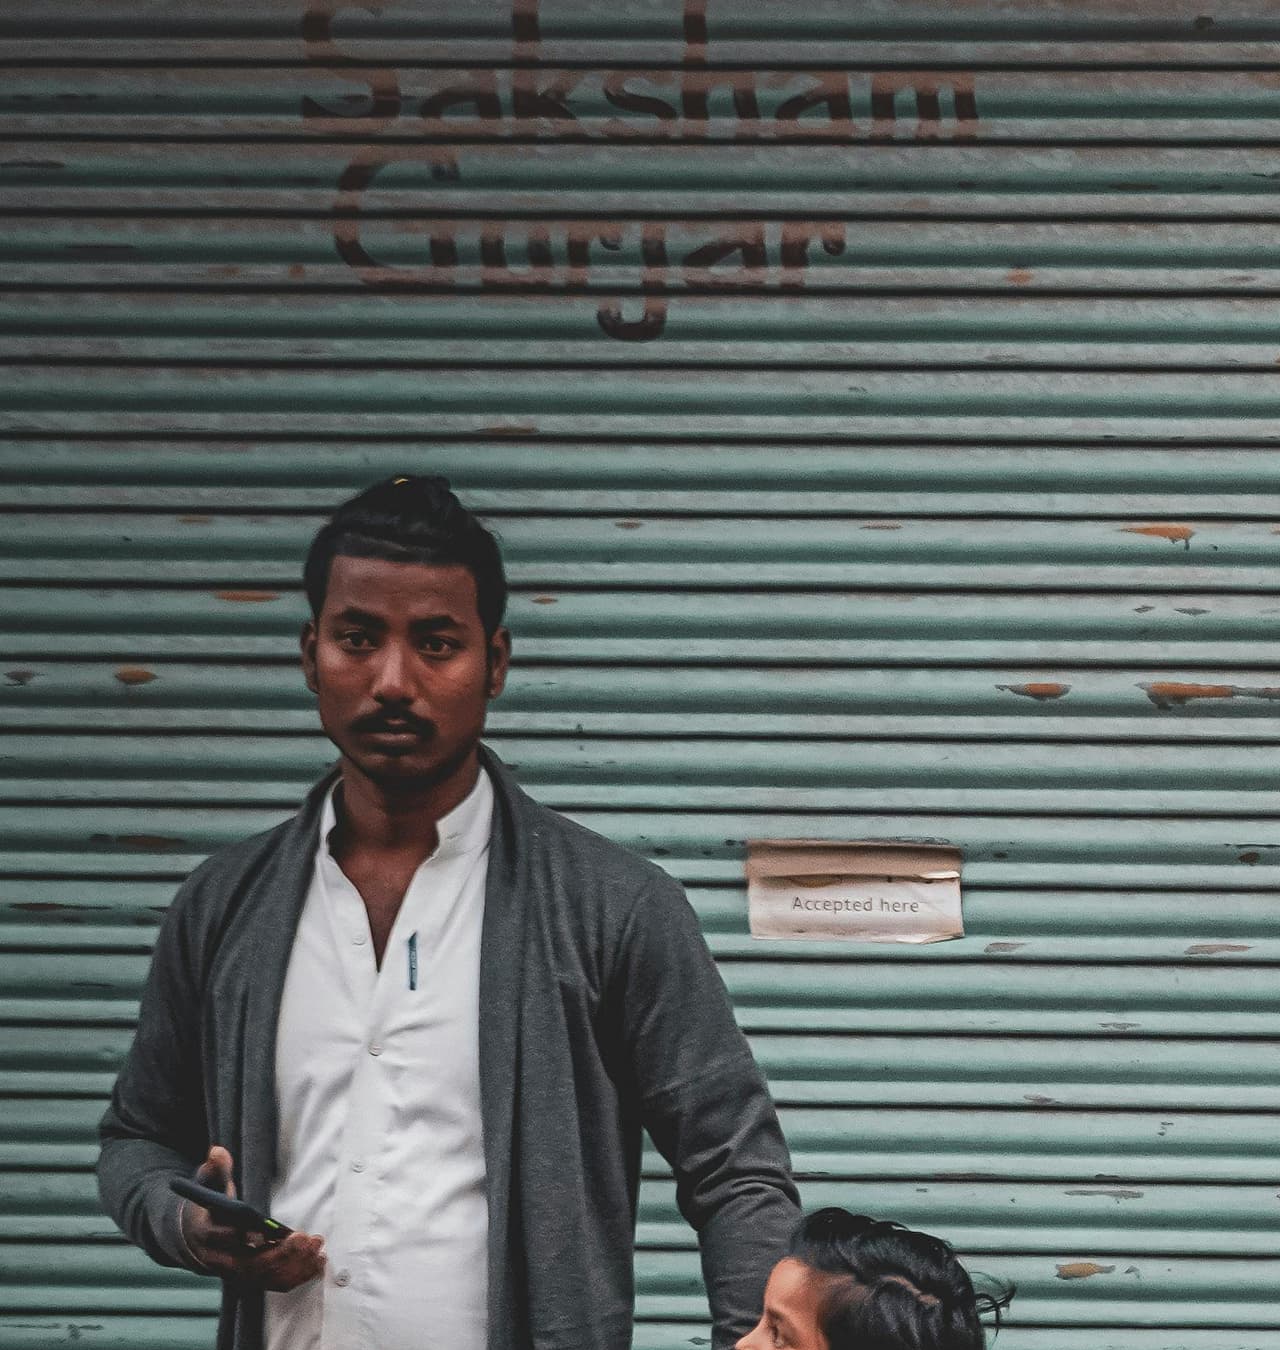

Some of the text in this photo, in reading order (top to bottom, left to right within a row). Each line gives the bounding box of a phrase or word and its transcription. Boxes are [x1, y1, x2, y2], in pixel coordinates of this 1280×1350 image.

[333, 148, 847, 342] Gurjar
[792, 897, 919, 915] Accepted here
